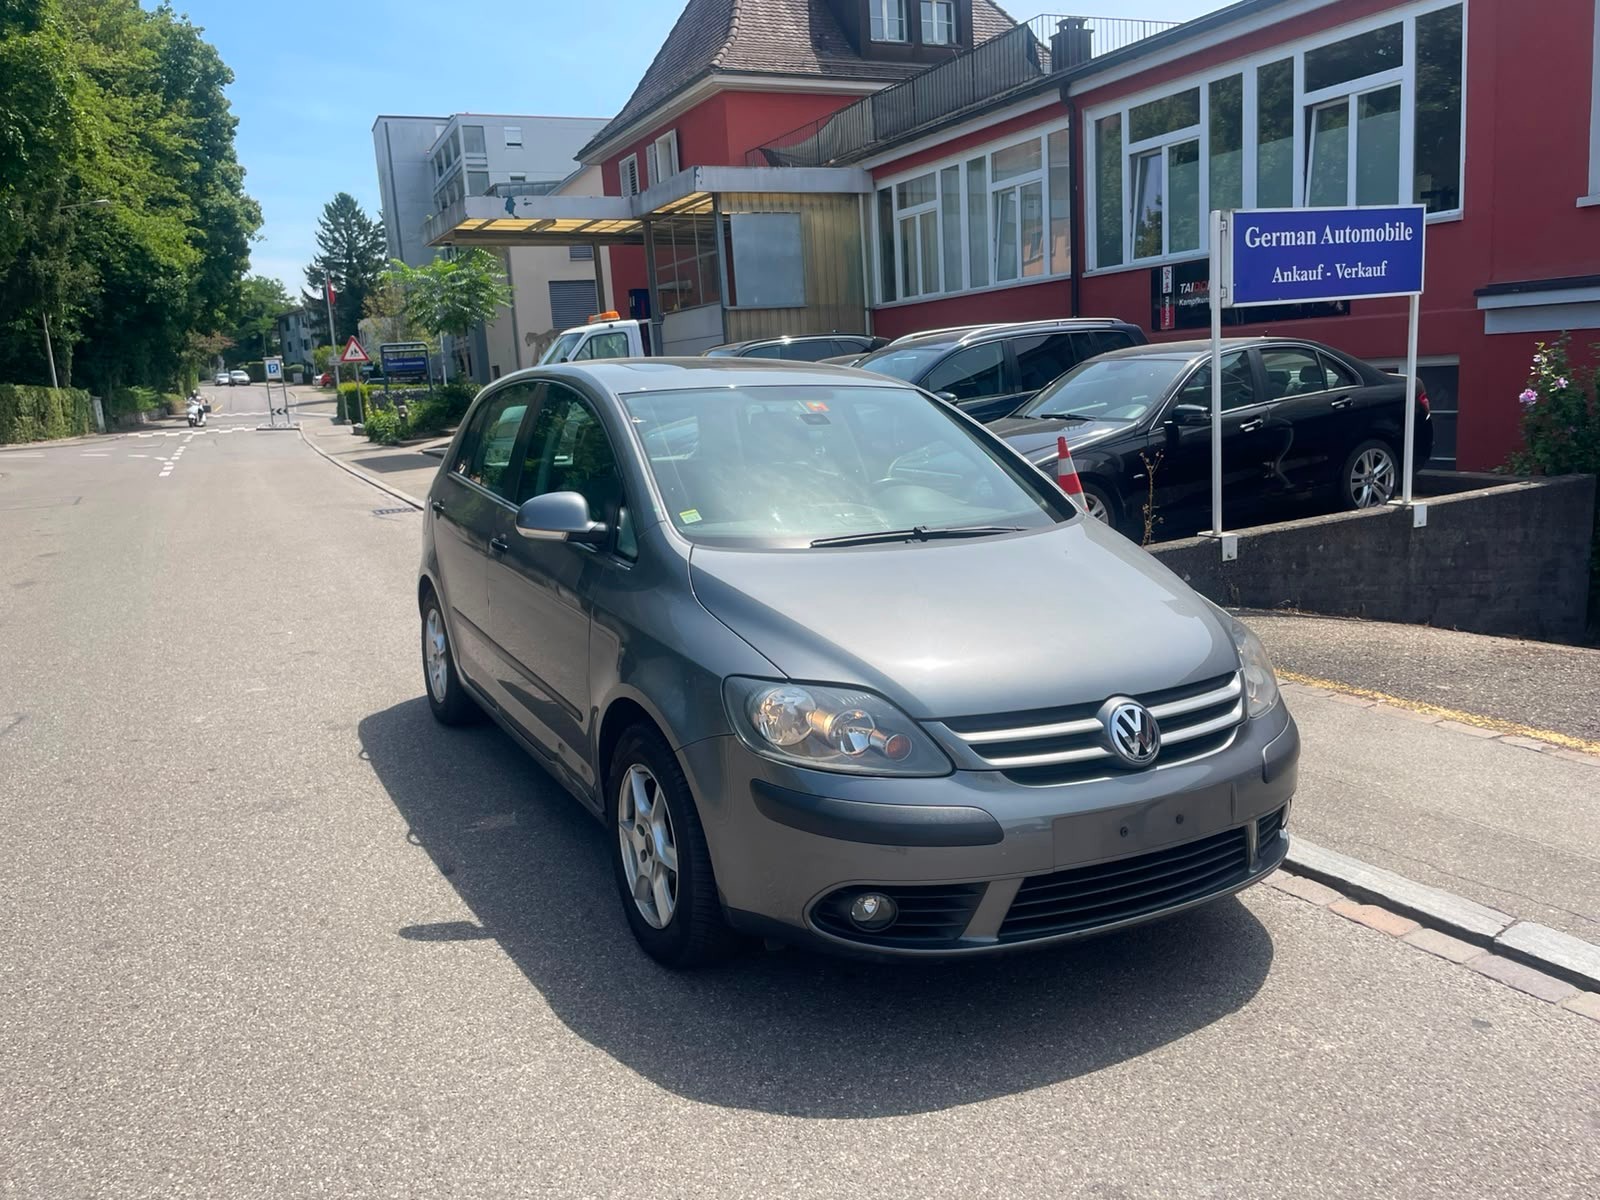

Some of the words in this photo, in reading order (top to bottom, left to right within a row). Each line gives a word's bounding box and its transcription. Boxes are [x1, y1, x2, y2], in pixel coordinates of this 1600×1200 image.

[1245, 226, 1316, 247] German
[1321, 222, 1413, 244] Automobile
[1271, 263, 1324, 283] Ankauf
[1335, 260, 1388, 279] Verkauf
[1111, 704, 1157, 760] VW
